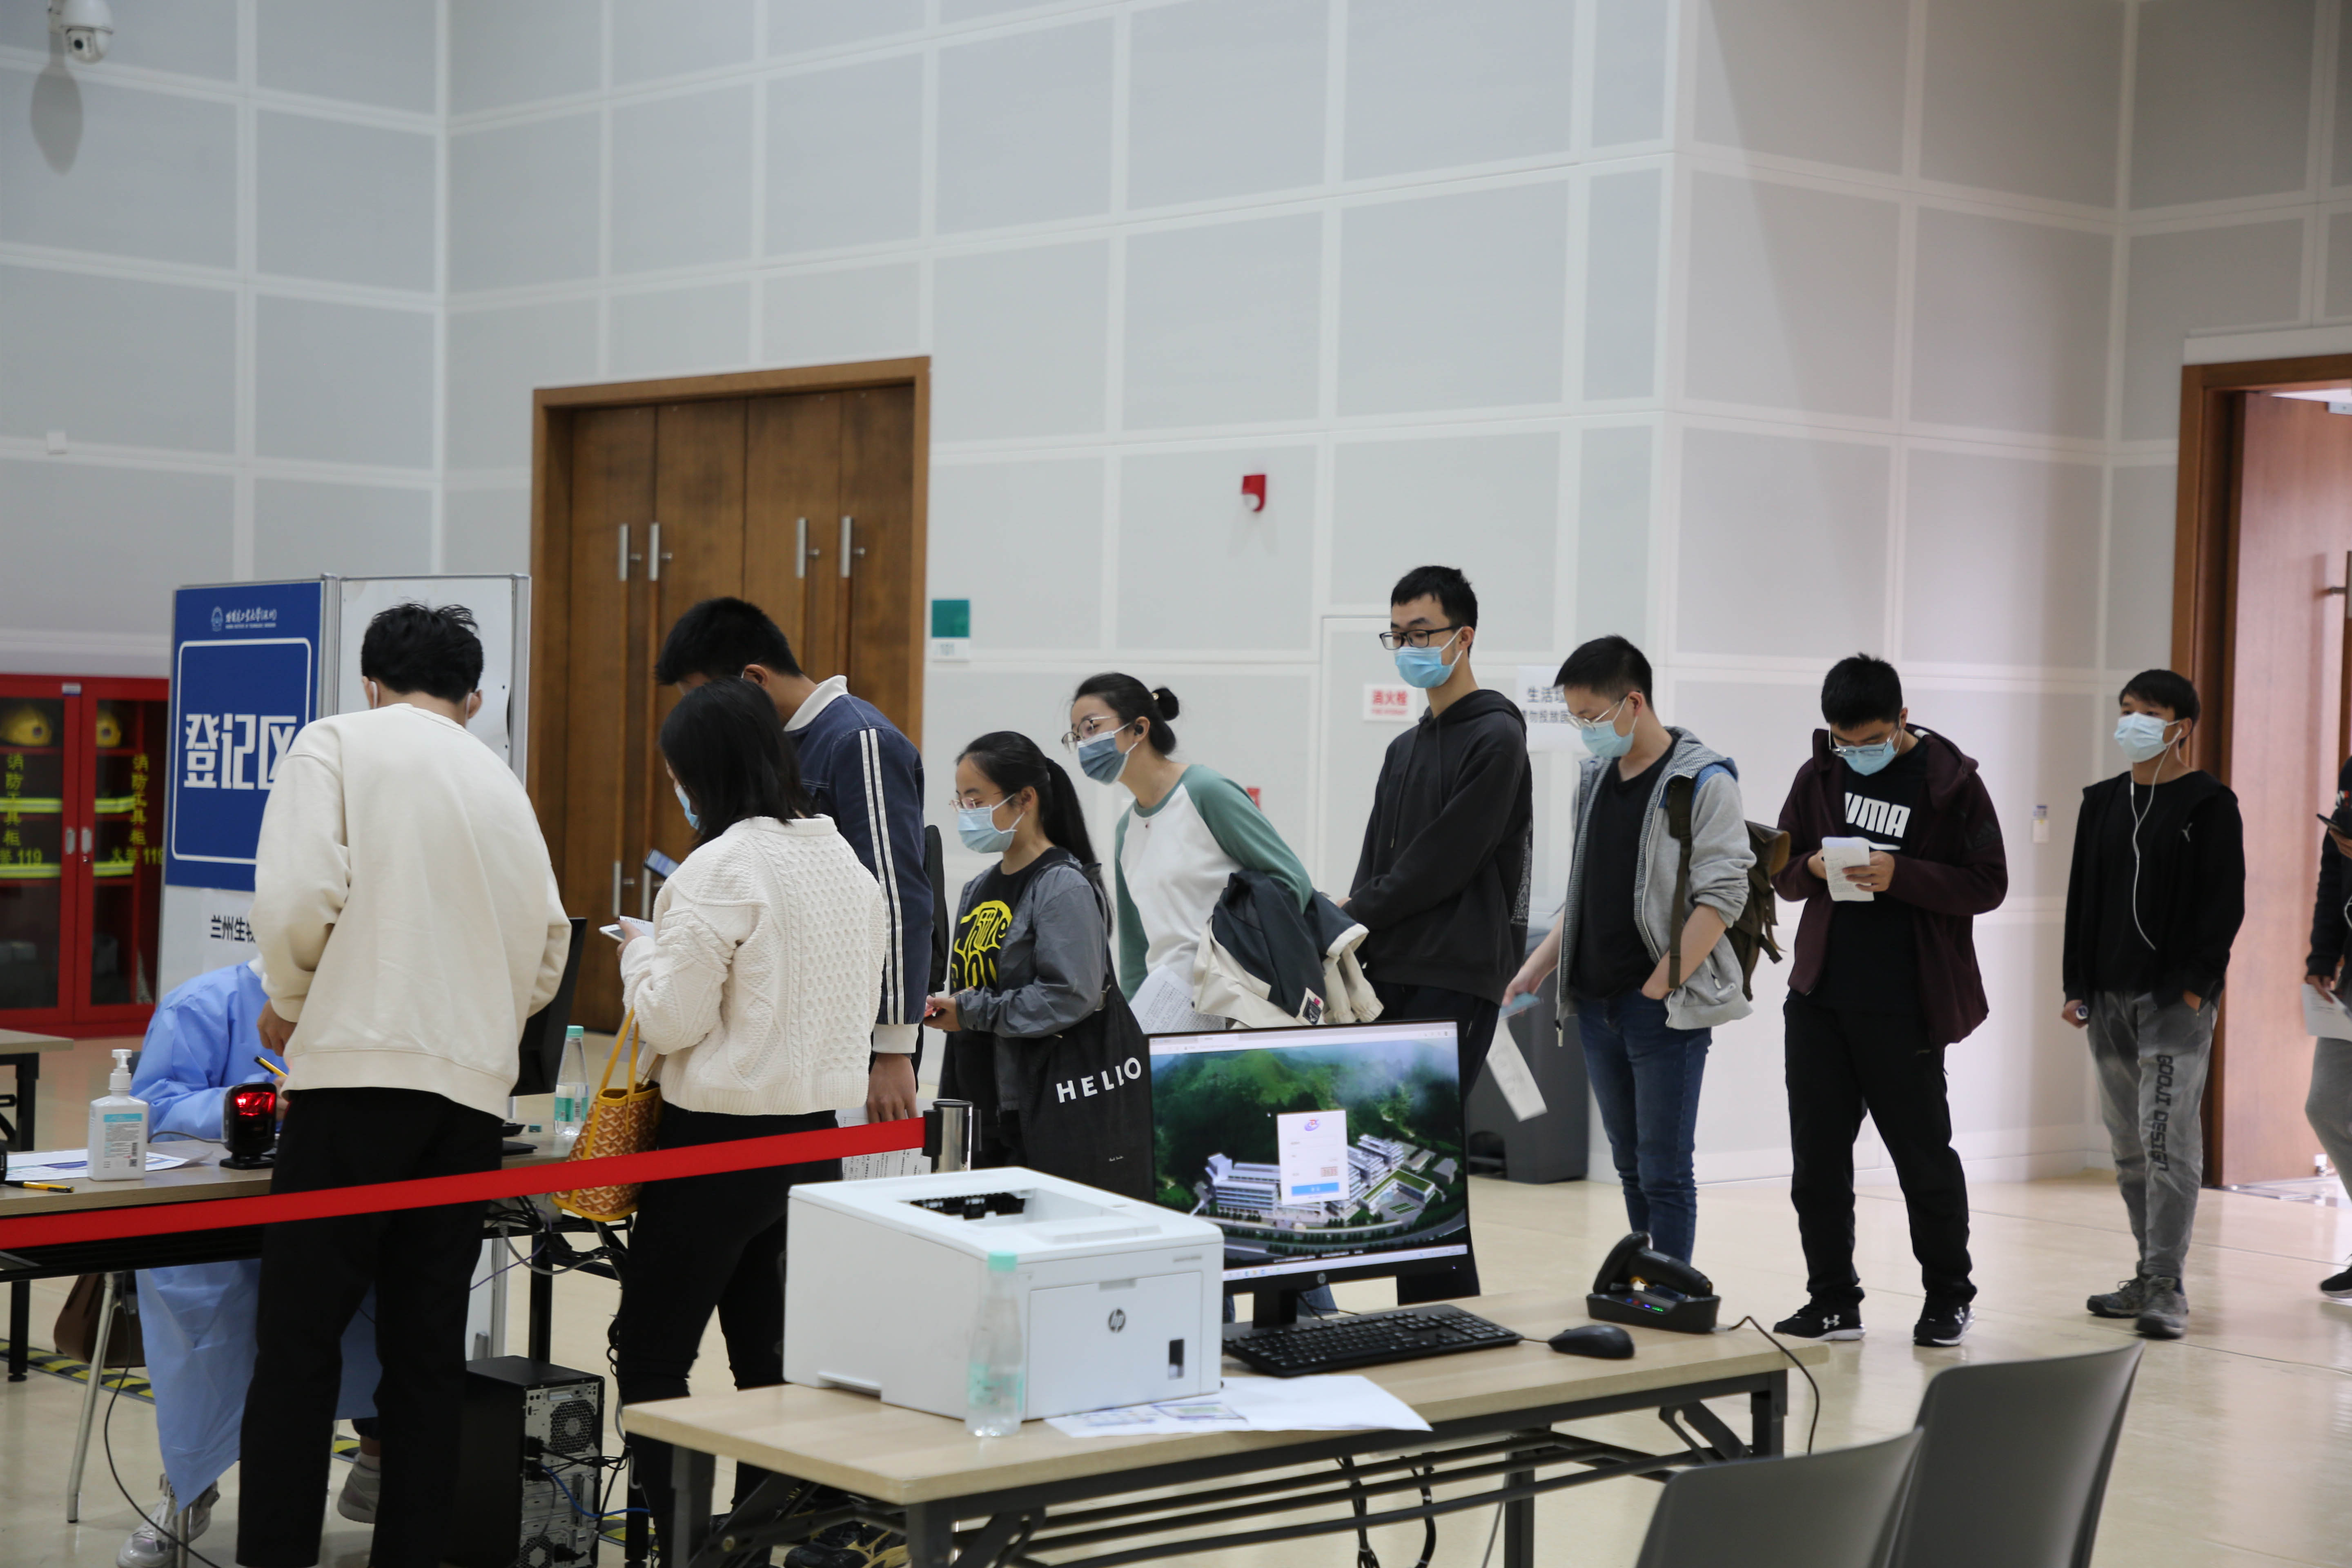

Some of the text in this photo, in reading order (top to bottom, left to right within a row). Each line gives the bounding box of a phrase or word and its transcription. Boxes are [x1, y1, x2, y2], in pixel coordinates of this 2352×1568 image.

[184, 713, 297, 790] 登记区
[1845, 792, 1911, 838] UMA
